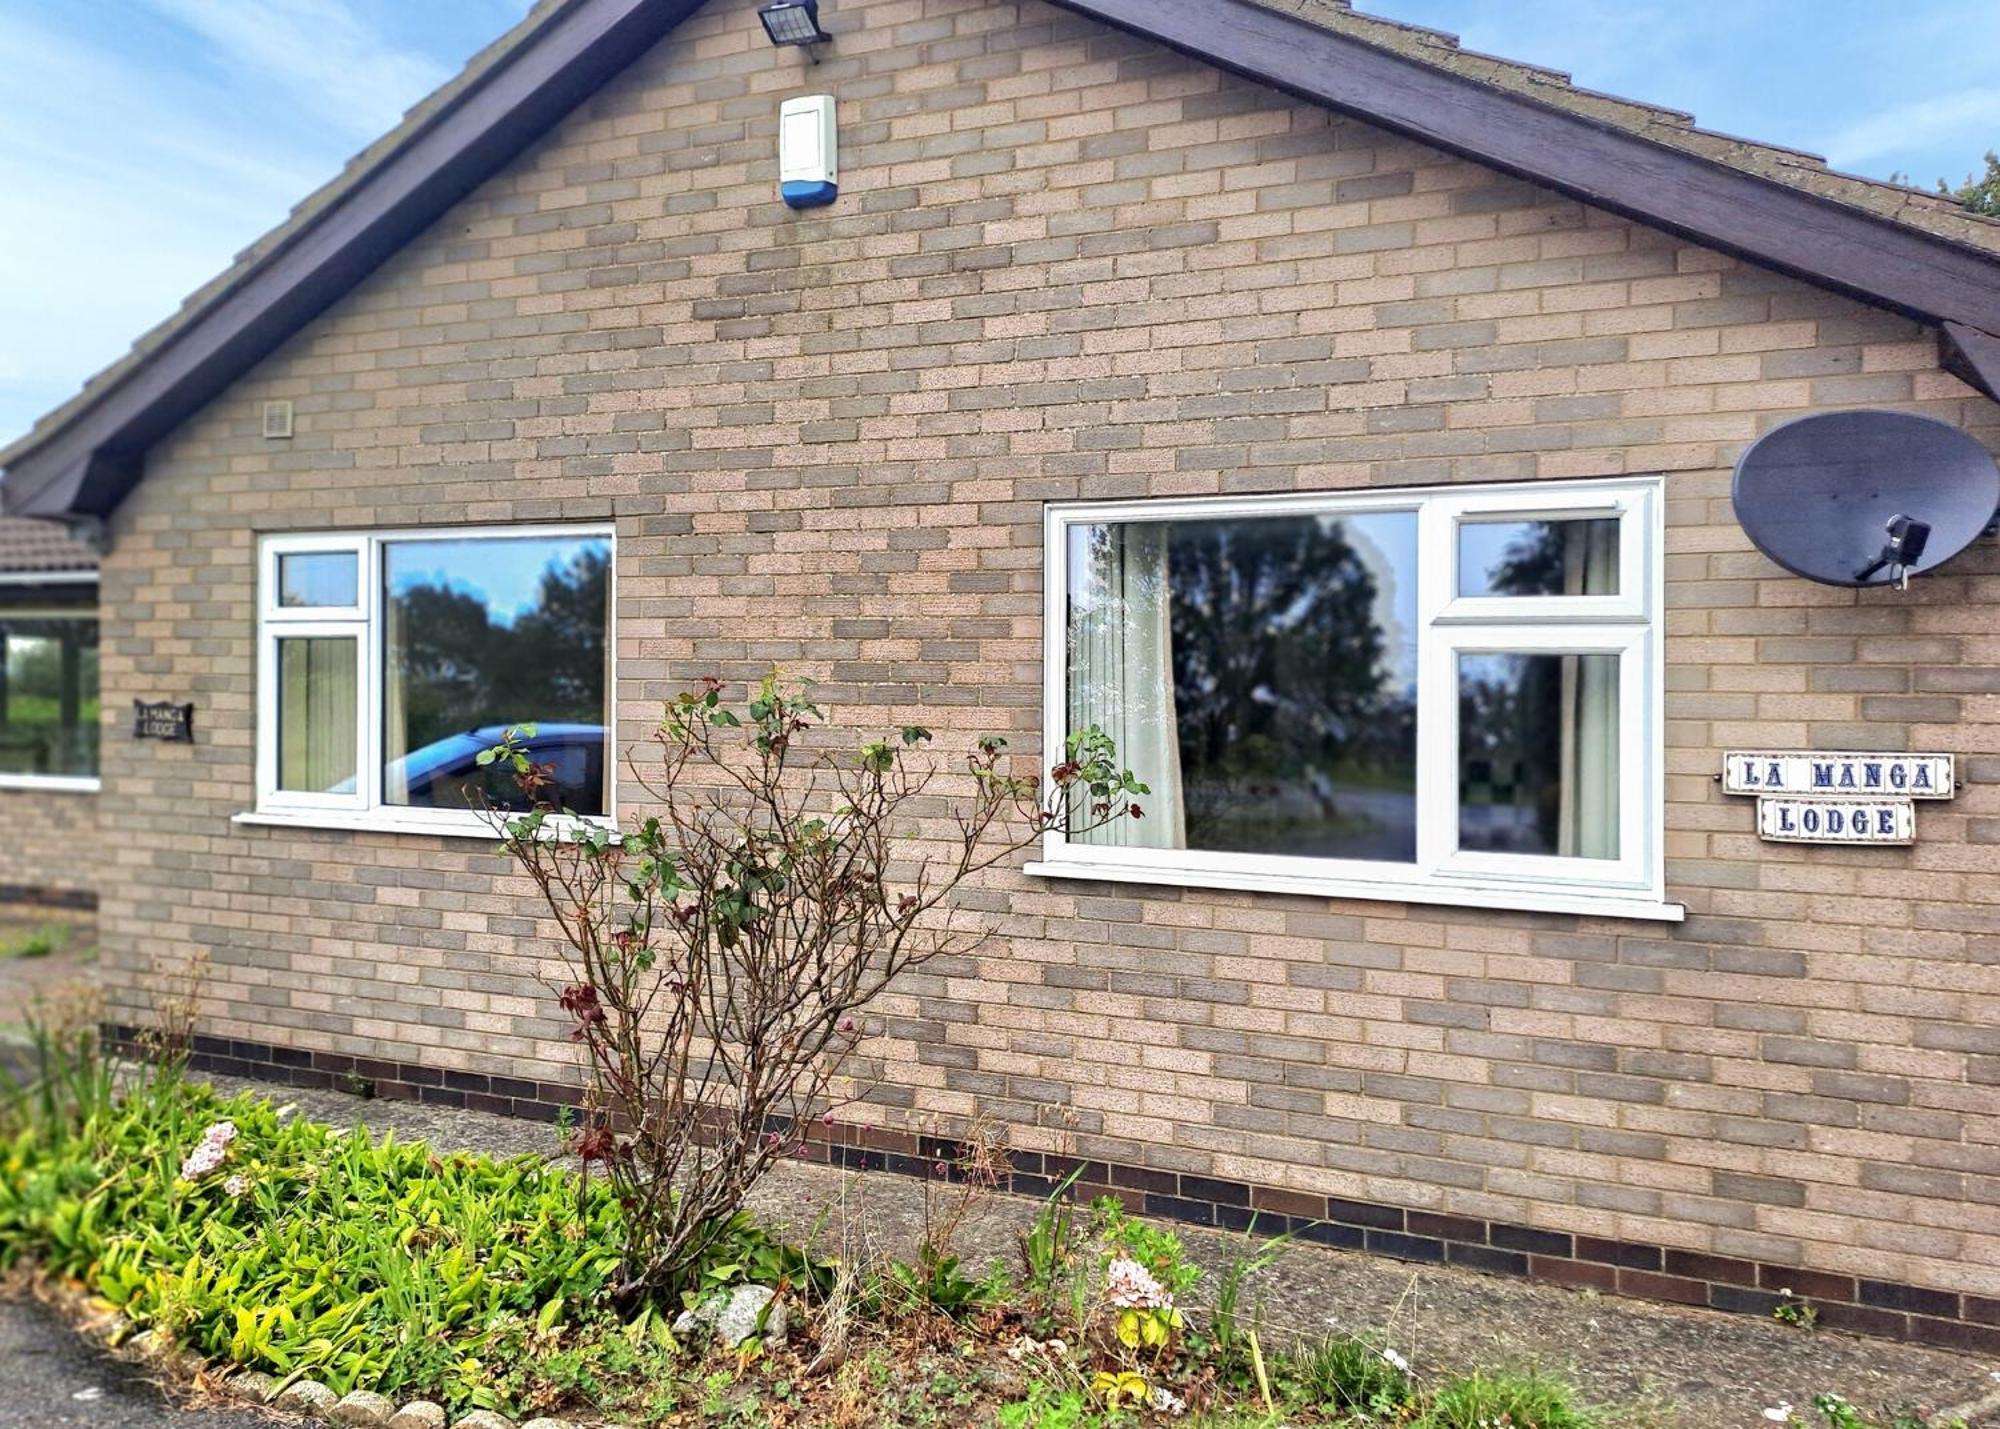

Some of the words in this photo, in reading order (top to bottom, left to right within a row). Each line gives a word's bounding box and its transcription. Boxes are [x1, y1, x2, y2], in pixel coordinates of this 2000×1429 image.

[1744, 761, 1784, 787] LA
[1813, 763, 1932, 789] MANGA
[1779, 808, 1895, 834] LODGE
